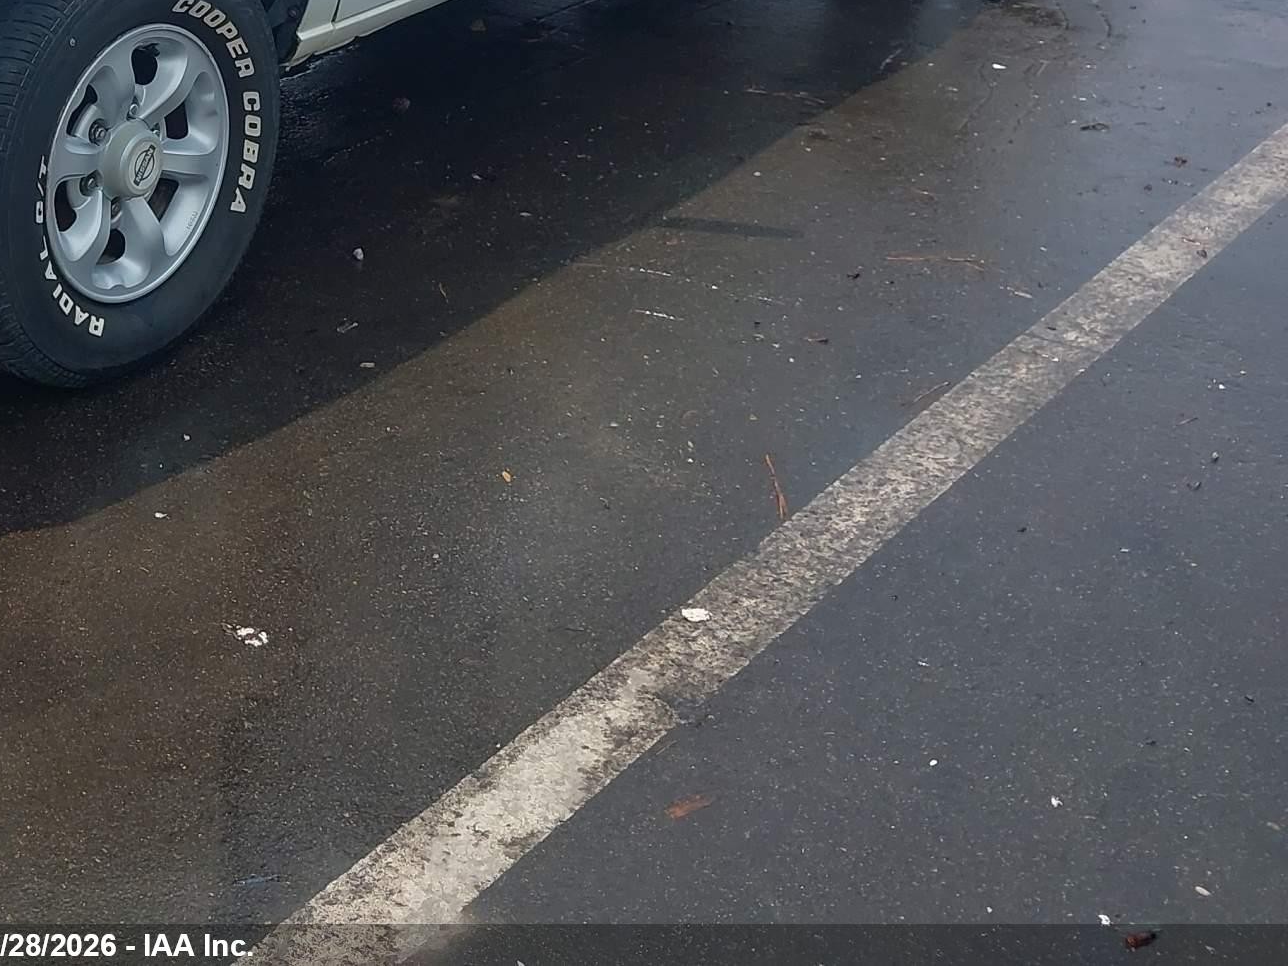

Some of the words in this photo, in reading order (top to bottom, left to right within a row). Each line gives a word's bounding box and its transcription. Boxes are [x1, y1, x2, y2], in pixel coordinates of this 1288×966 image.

[35, 155, 48, 224] G/T
[134, 147, 154, 183] NISSAN
[230, 91, 261, 213] COBRA
[38, 236, 105, 337] RADIAL
